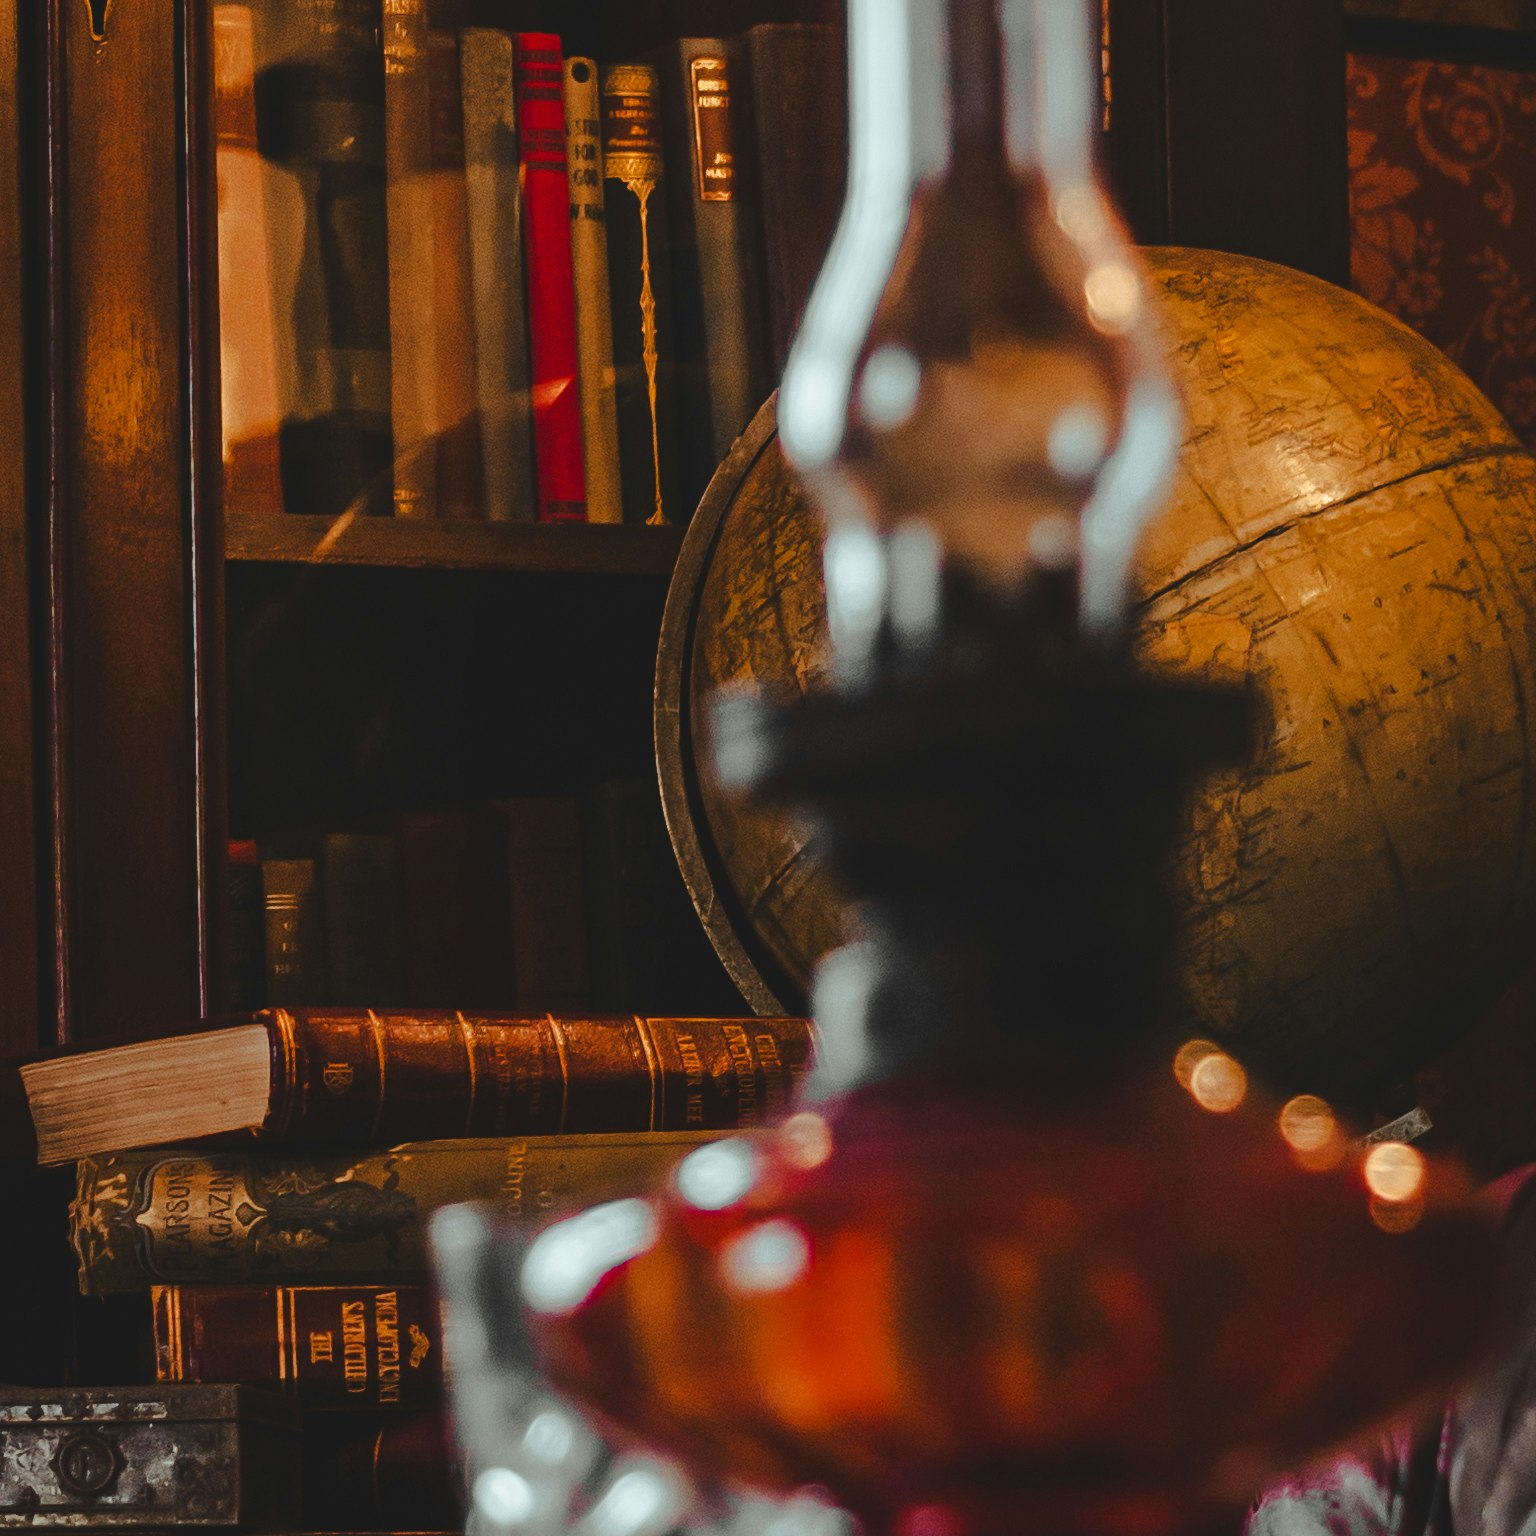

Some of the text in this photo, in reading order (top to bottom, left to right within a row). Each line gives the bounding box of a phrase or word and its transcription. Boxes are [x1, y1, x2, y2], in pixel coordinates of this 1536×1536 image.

[686, 1092, 704, 1124] MEE
[500, 1141, 527, 1201] JUNE
[309, 1330, 334, 1365] THE
[375, 1290, 401, 1403] ENCYCLOPEDIA
